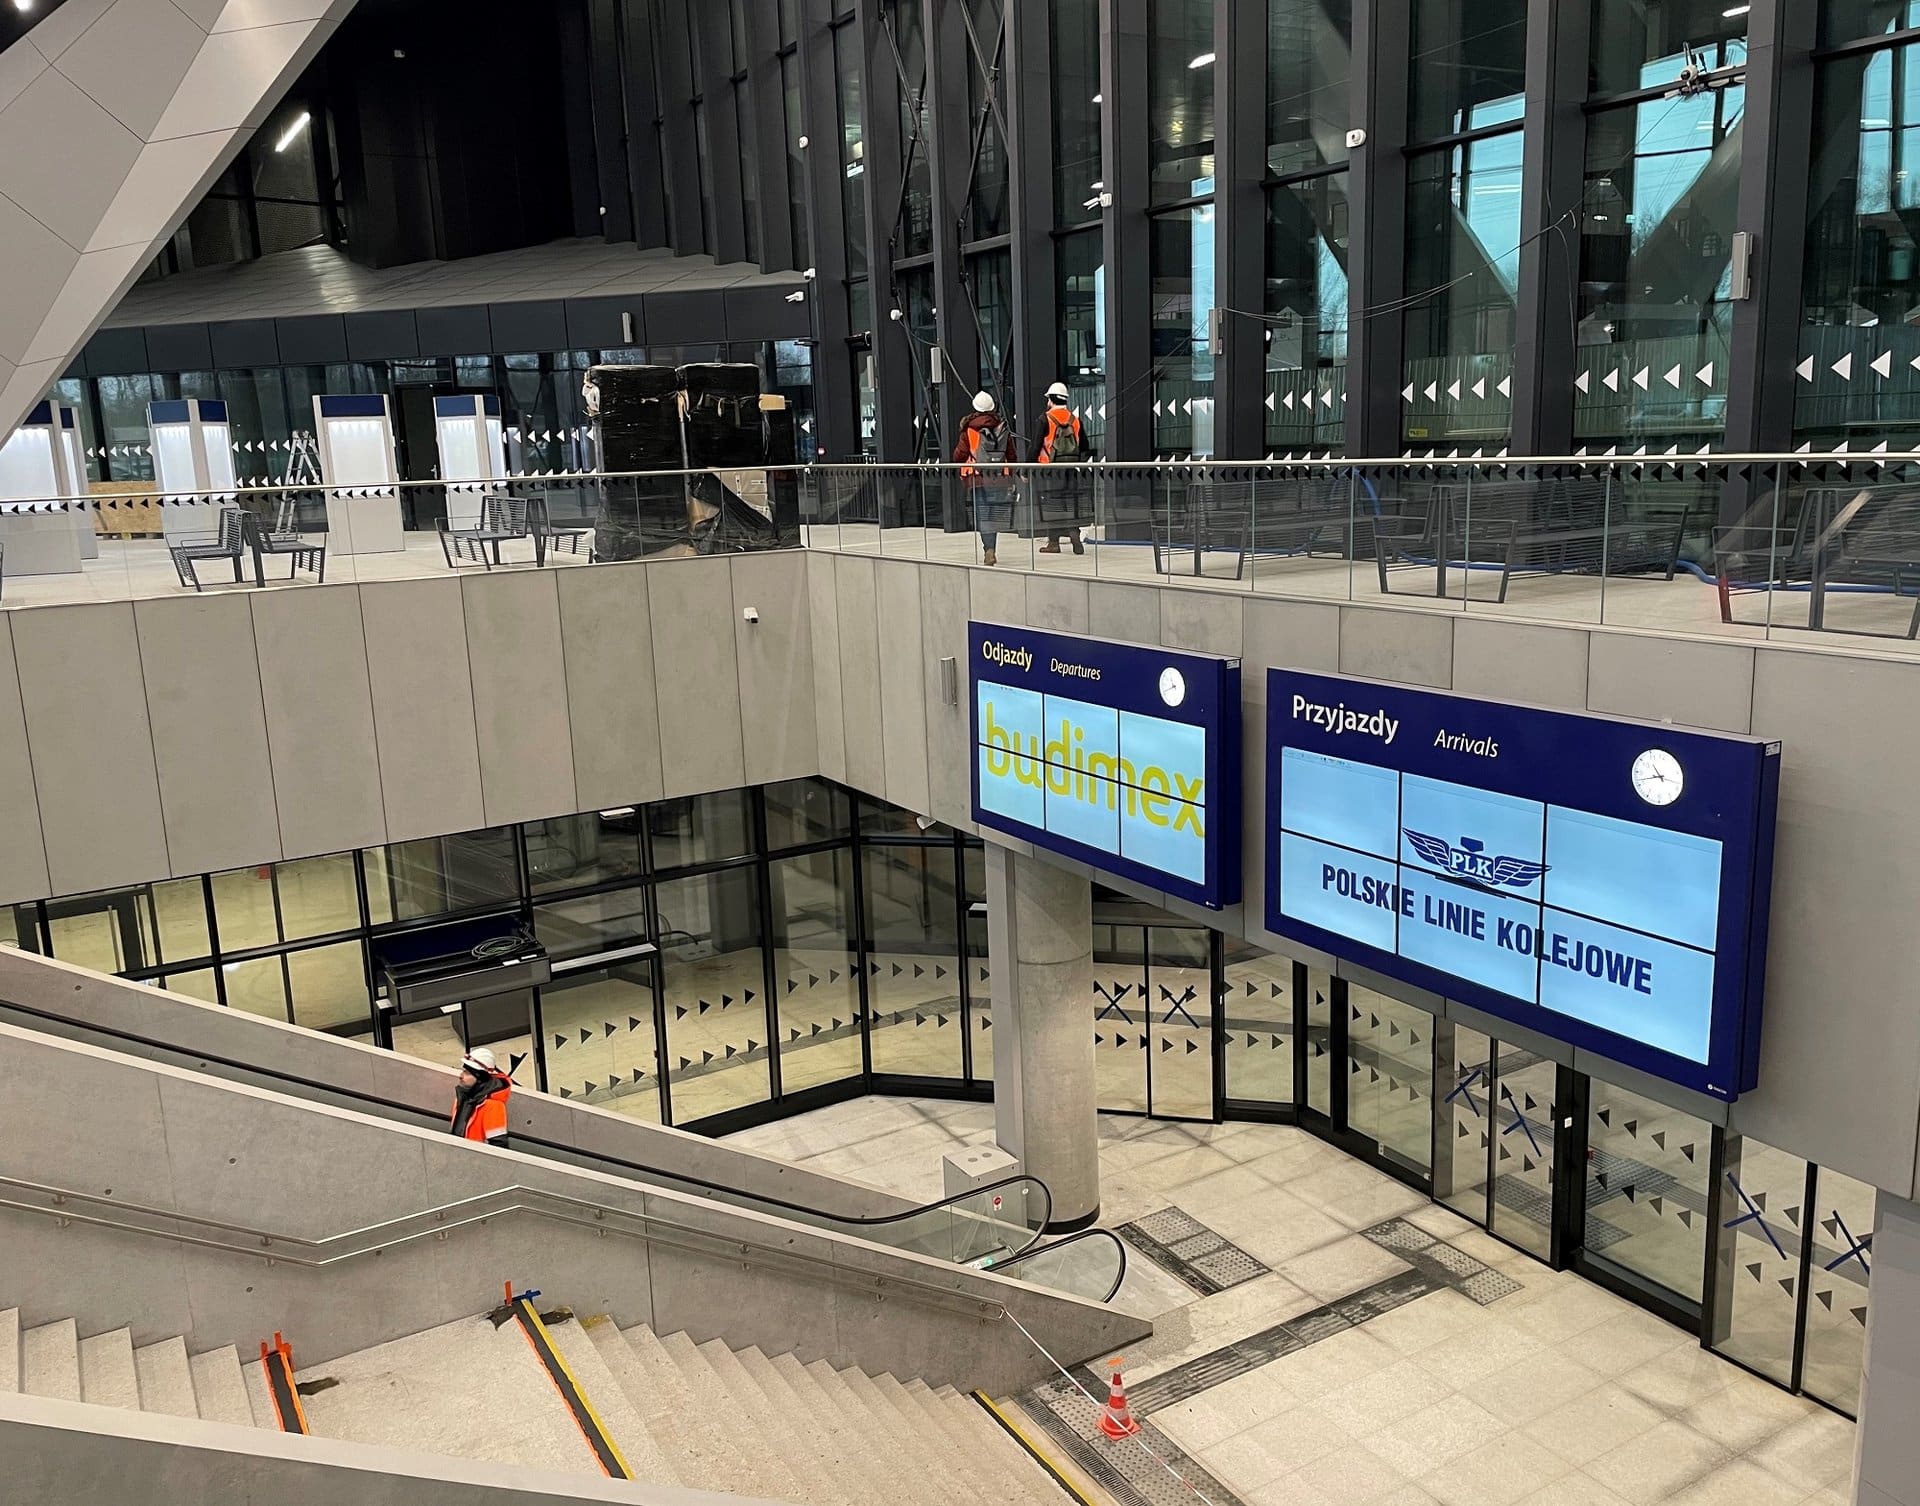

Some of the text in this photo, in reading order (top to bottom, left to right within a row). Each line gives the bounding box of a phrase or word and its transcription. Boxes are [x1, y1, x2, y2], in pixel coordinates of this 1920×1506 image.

[983, 641, 1101, 680] Odjazdy Departures
[1293, 695, 1498, 757] Przyjazdy Arrivals
[986, 701, 1204, 838] budimex
[1451, 851, 1492, 878] PLK
[1323, 864, 1652, 995] POLSKIE LINIE KOLEJOWE
